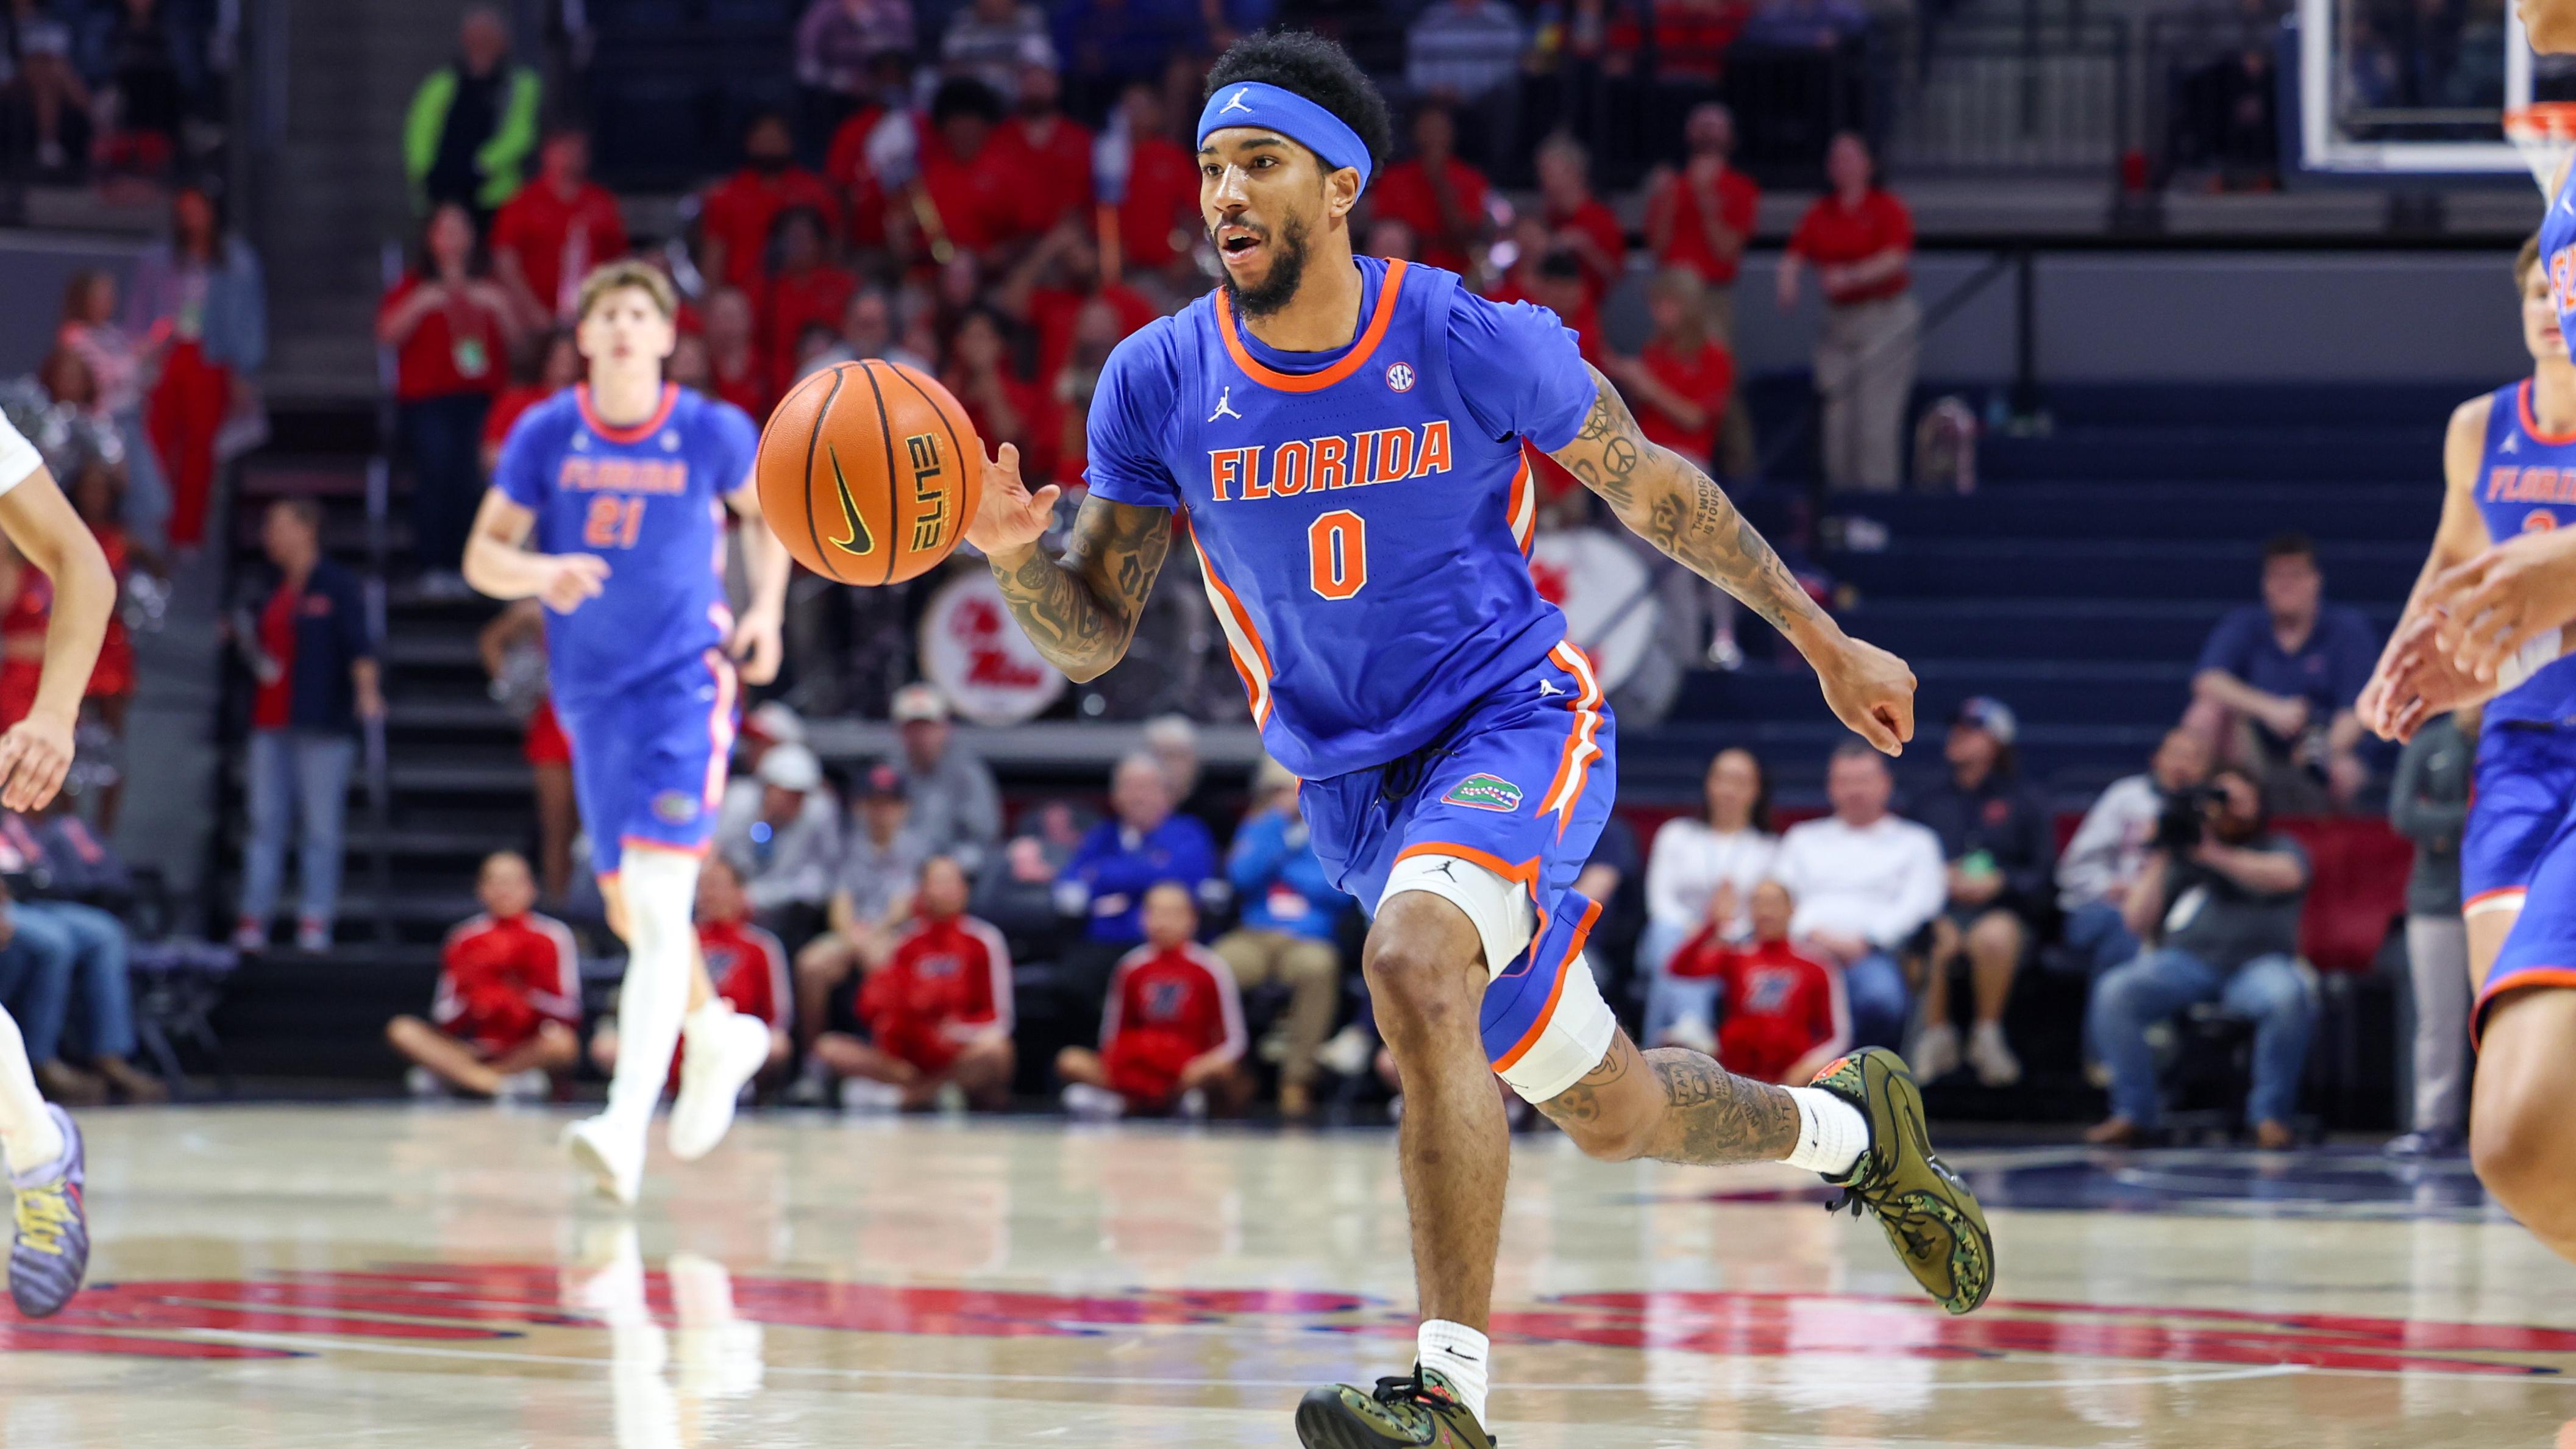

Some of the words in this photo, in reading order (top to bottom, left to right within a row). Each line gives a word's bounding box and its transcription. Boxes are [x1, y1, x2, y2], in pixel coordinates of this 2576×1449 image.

[1389, 365, 1413, 390] SEC
[1207, 420, 1453, 501] FLORIDA
[2486, 466, 2576, 504] FLORI
[905, 432, 941, 553] ELITE
[583, 495, 647, 549] 21
[1692, 511, 1706, 530] THE
[1308, 508, 1368, 600] 0
